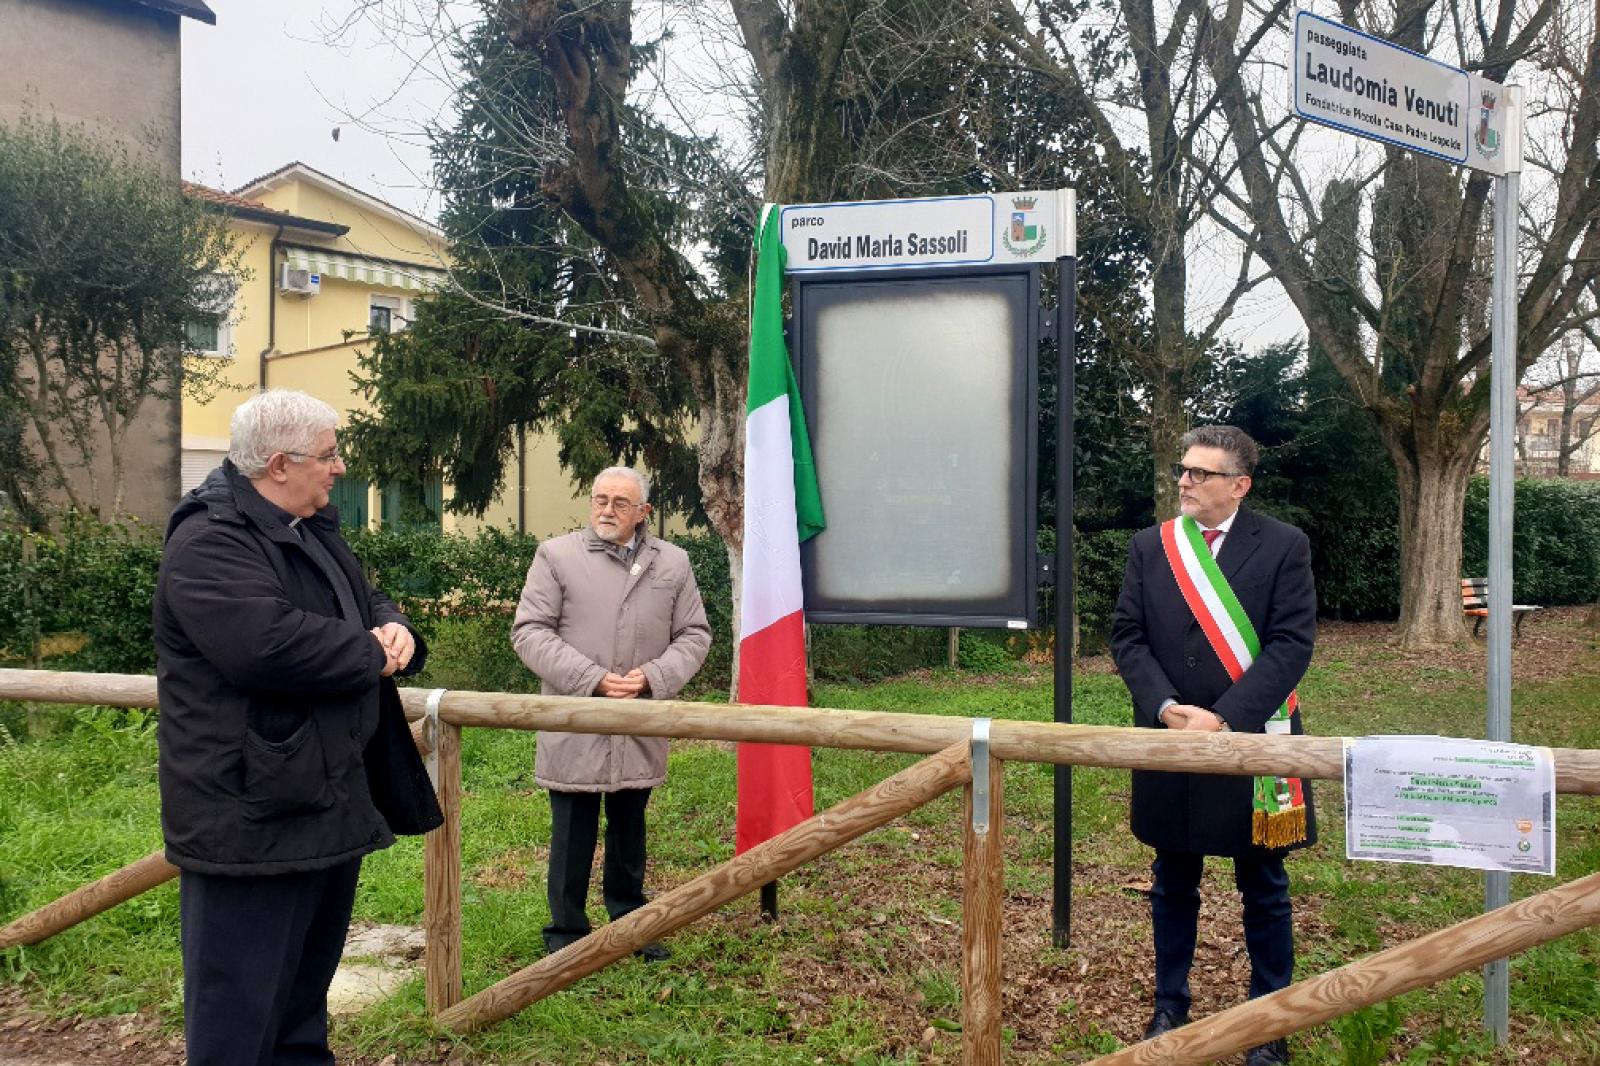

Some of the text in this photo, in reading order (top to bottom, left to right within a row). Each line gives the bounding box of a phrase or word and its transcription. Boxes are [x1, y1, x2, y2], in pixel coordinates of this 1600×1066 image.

[1307, 29, 1367, 60] passeggiata
[1306, 52, 1459, 127] Laudomia Venuti
[791, 216, 825, 229] parco
[808, 230, 968, 261] David Maria Sassoli
